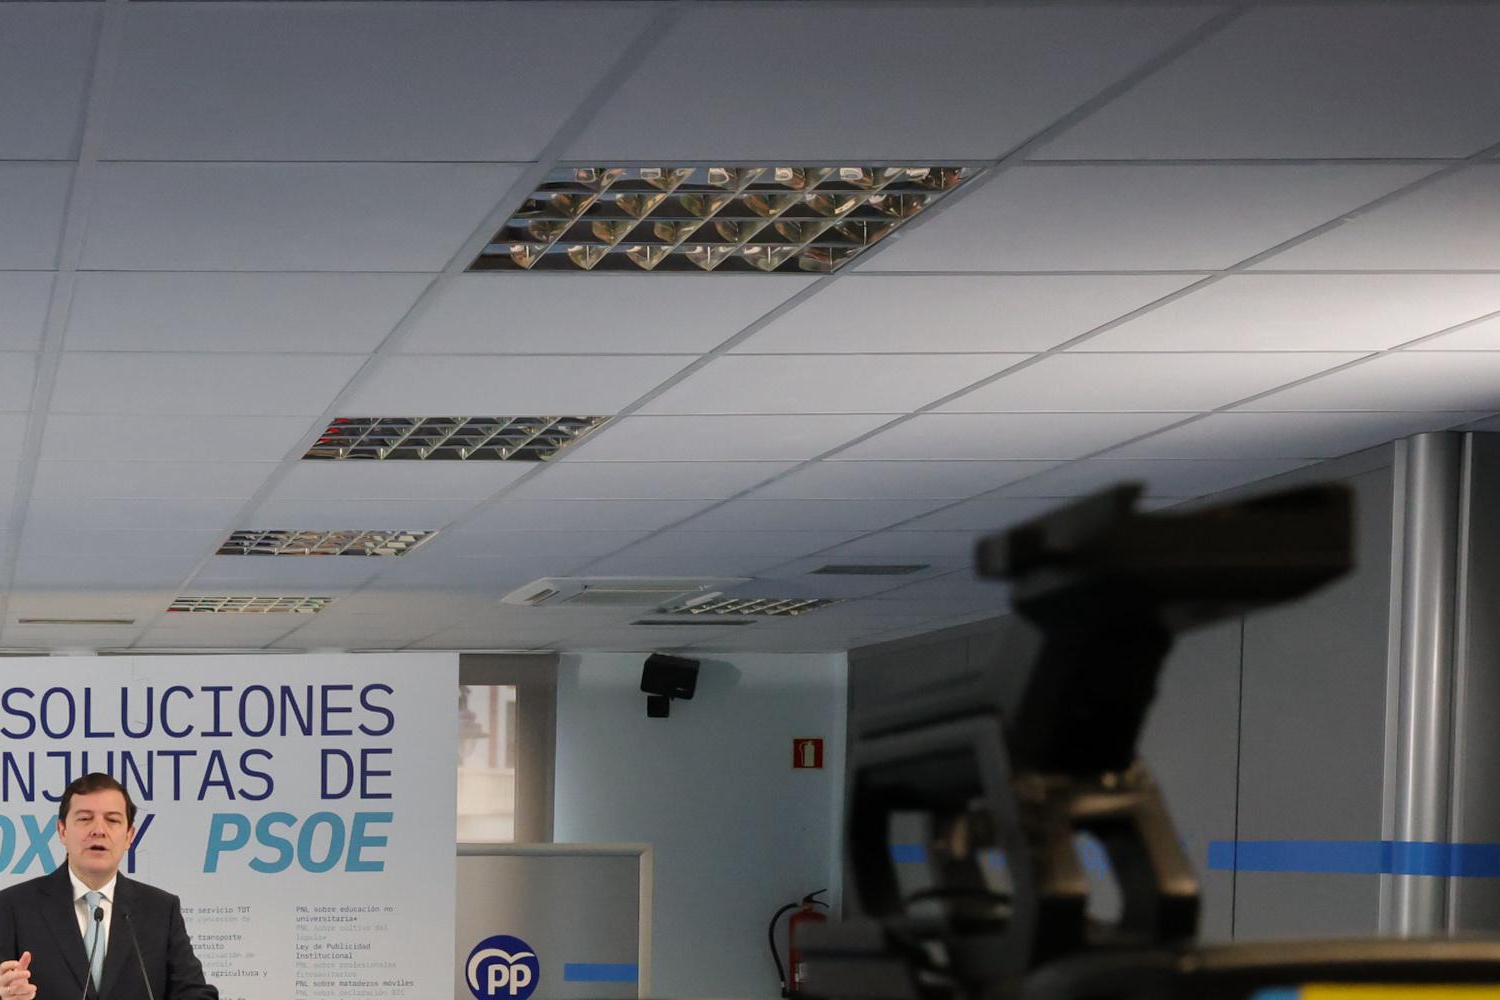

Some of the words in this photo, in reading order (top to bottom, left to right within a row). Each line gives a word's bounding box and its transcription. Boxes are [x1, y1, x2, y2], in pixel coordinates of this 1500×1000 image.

[320, 748, 393, 801] DE
[128, 813, 156, 874] Y
[203, 811, 394, 874] PSOE
[198, 934, 242, 942] transporte
[296, 943, 309, 951] Ley
[211, 970, 259, 978] agricultura
